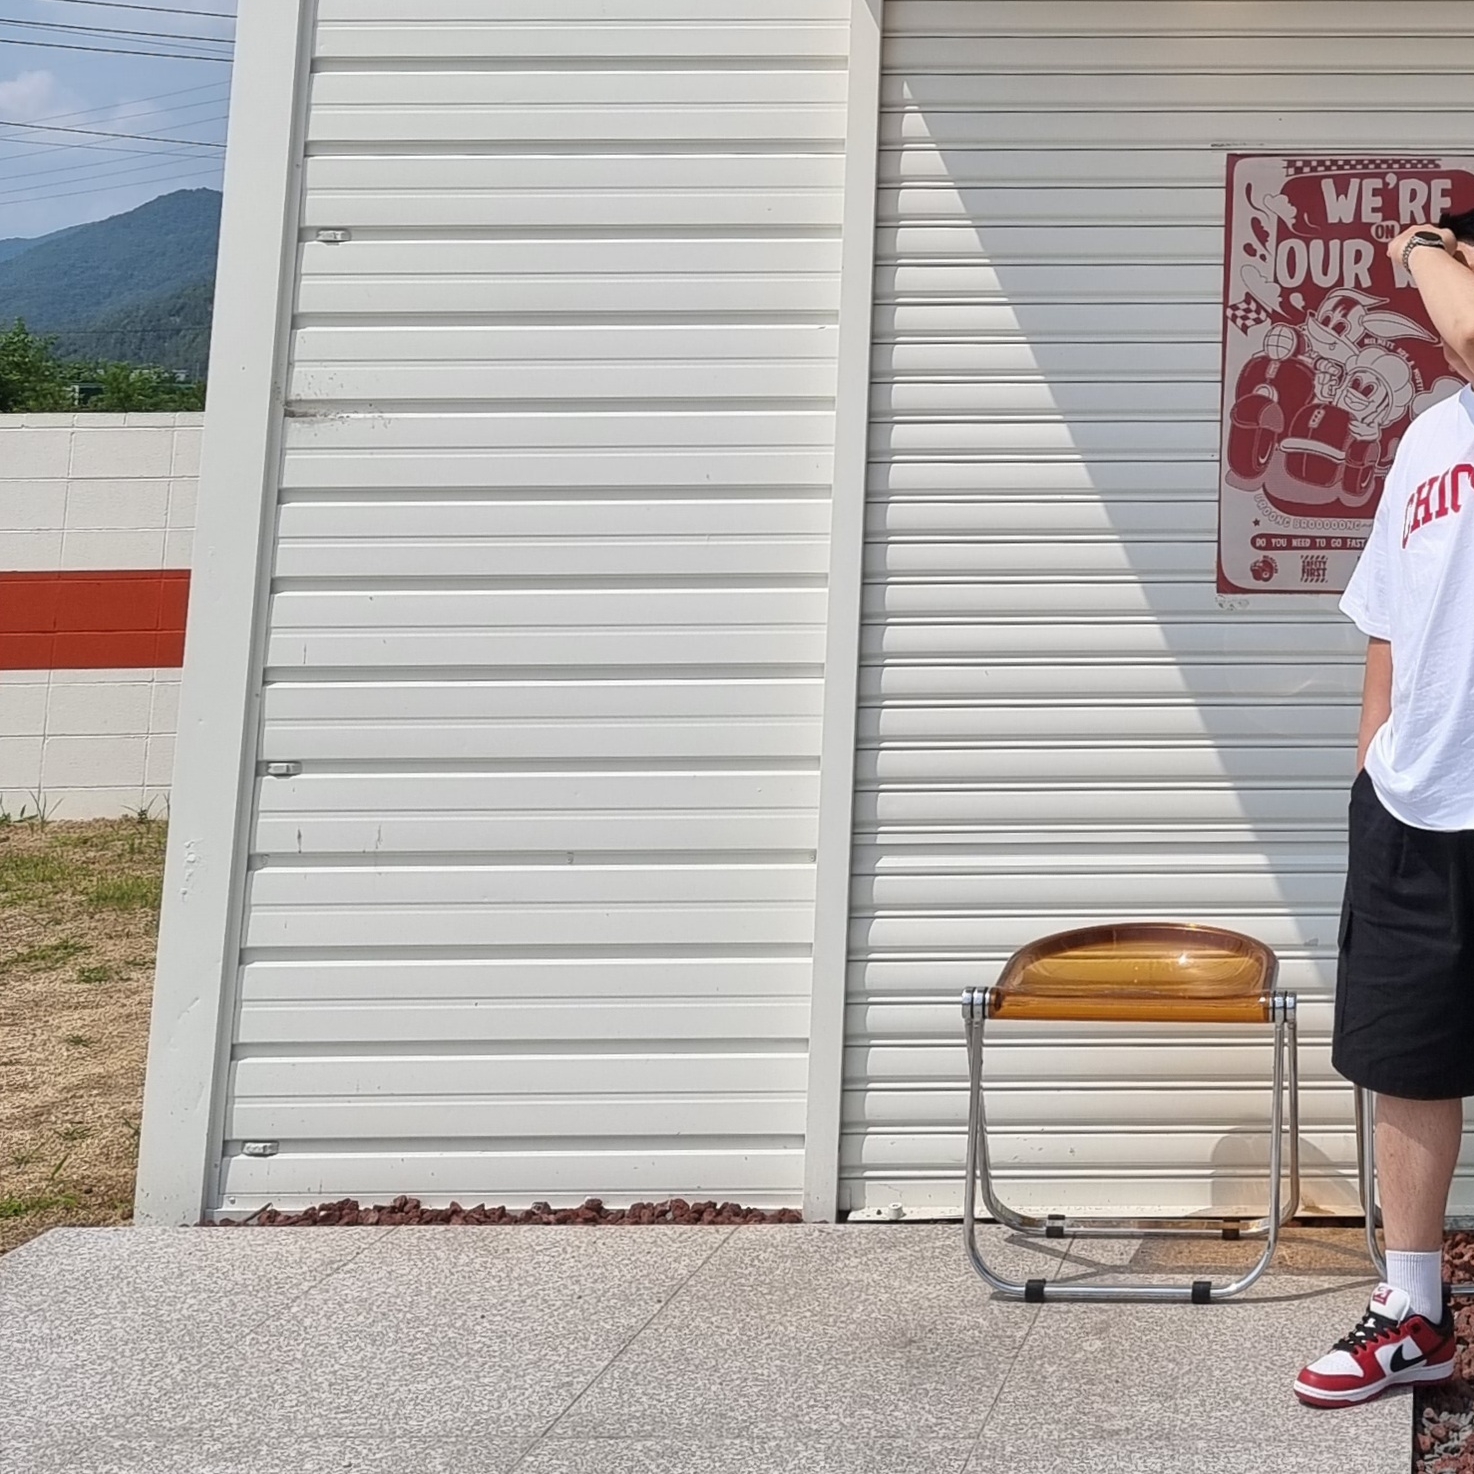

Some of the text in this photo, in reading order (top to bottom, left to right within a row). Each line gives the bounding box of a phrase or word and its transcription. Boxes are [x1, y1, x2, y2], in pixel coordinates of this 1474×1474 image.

[1321, 173, 1452, 224] WE'RE
[1375, 224, 1396, 240] ON
[1276, 239, 1375, 288] OUR
[1256, 538, 1267, 547] DO
[1271, 538, 1287, 547] YOU
[1292, 538, 1311, 547] NEED
[1316, 538, 1327, 547] TO
[1331, 538, 1342, 547] GO
[1302, 568, 1327, 577] FIRST
